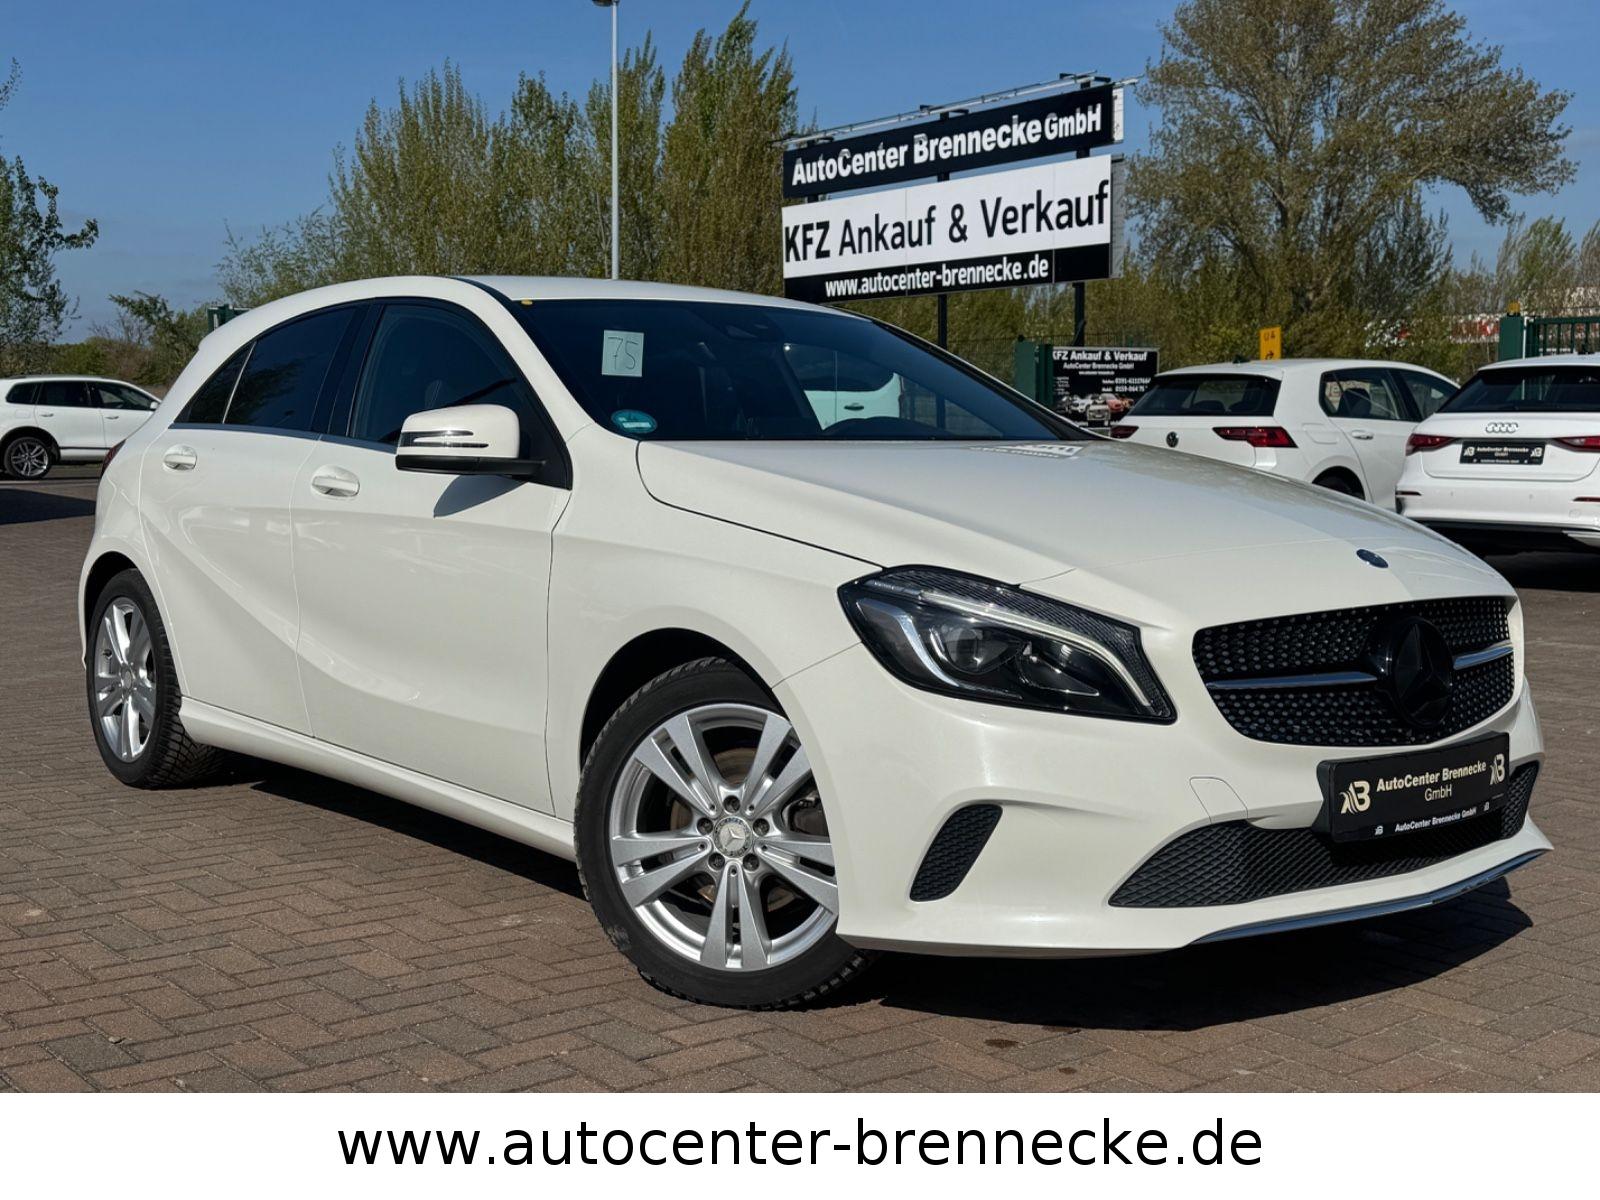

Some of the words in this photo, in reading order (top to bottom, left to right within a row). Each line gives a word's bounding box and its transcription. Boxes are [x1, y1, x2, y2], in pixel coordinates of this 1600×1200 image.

[792, 142, 909, 186] AutoCenter
[913, 115, 1042, 164] Brennecke
[1044, 103, 1101, 141] GmbH
[784, 219, 830, 263] KFZ
[838, 205, 937, 256] Ankauf
[949, 202, 968, 243] &
[980, 179, 1109, 238] Verkauf
[825, 253, 1049, 298] www.autocenter-brennecke.de
[607, 336, 639, 370] 75
[1070, 350, 1102, 361] Ankauf
[1104, 351, 1112, 361] &
[1113, 351, 1148, 361] Verkauf
[1376, 772, 1440, 793] AutoCenter
[1442, 760, 1488, 780] Brennecke
[1424, 784, 1453, 803] GmbH
[1394, 819, 1431, 833] AutoCenter
[1432, 813, 1461, 826] Brennecke
[1461, 807, 1478, 819] GmbH
